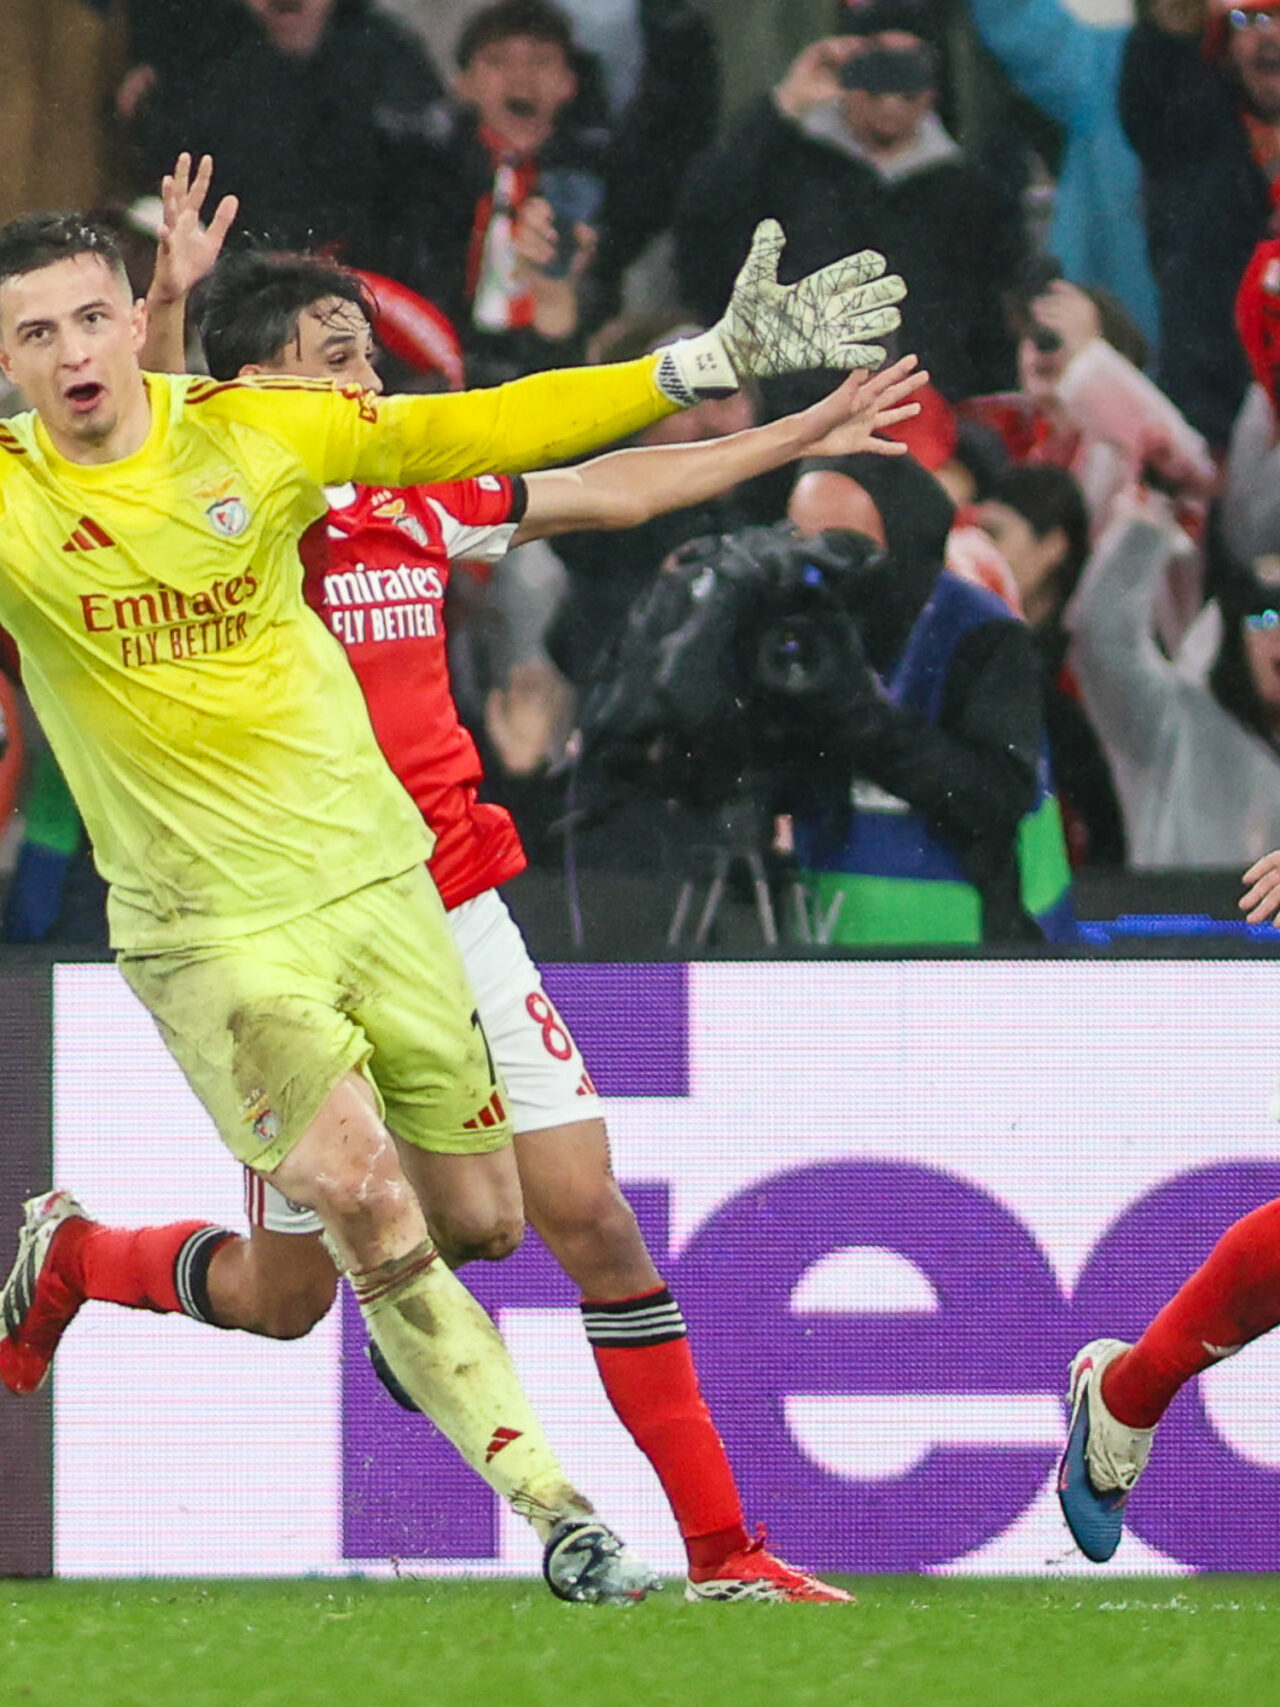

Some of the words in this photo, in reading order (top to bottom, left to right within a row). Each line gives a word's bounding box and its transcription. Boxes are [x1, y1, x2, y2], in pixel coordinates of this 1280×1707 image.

[79, 566, 258, 632] Emirates
[323, 562, 443, 606] mirates
[121, 631, 159, 668] FLY
[169, 610, 248, 660] BETTER
[371, 603, 437, 642] BETTER
[525, 991, 573, 1061] 8
